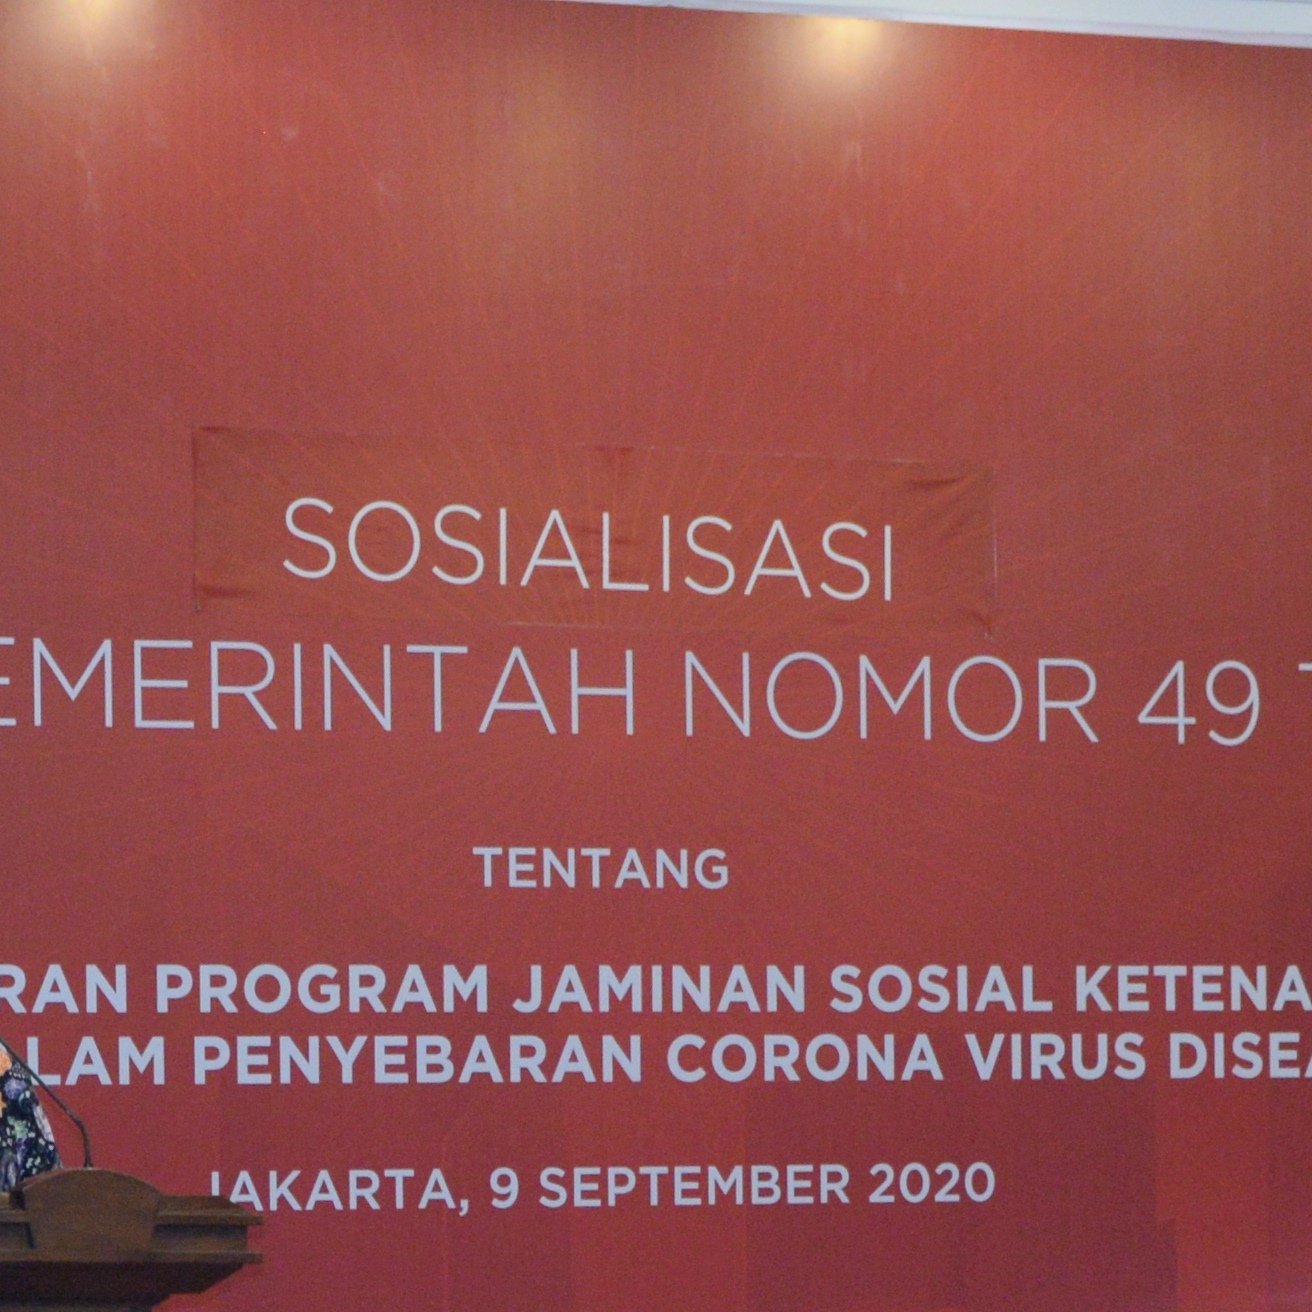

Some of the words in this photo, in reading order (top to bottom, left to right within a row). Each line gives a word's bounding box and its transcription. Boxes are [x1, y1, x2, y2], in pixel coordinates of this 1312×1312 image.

[282, 497, 892, 601] SOSIALISASI
[685, 650, 1099, 743] NOMOR
[1137, 660, 1260, 747] 49
[472, 846, 729, 890] TENTANG
[156, 962, 488, 1013] PROGRAM
[512, 963, 805, 1013] JAMINAN
[830, 964, 1053, 1013] SOSIAL
[194, 1034, 642, 1085] PENYEBARAN
[667, 1033, 944, 1083] CORONA
[964, 1032, 1146, 1081] VIRUS
[489, 1166, 519, 1209] 9
[539, 1163, 850, 1208] SEPTEMBER
[868, 1161, 996, 1204] 2020
